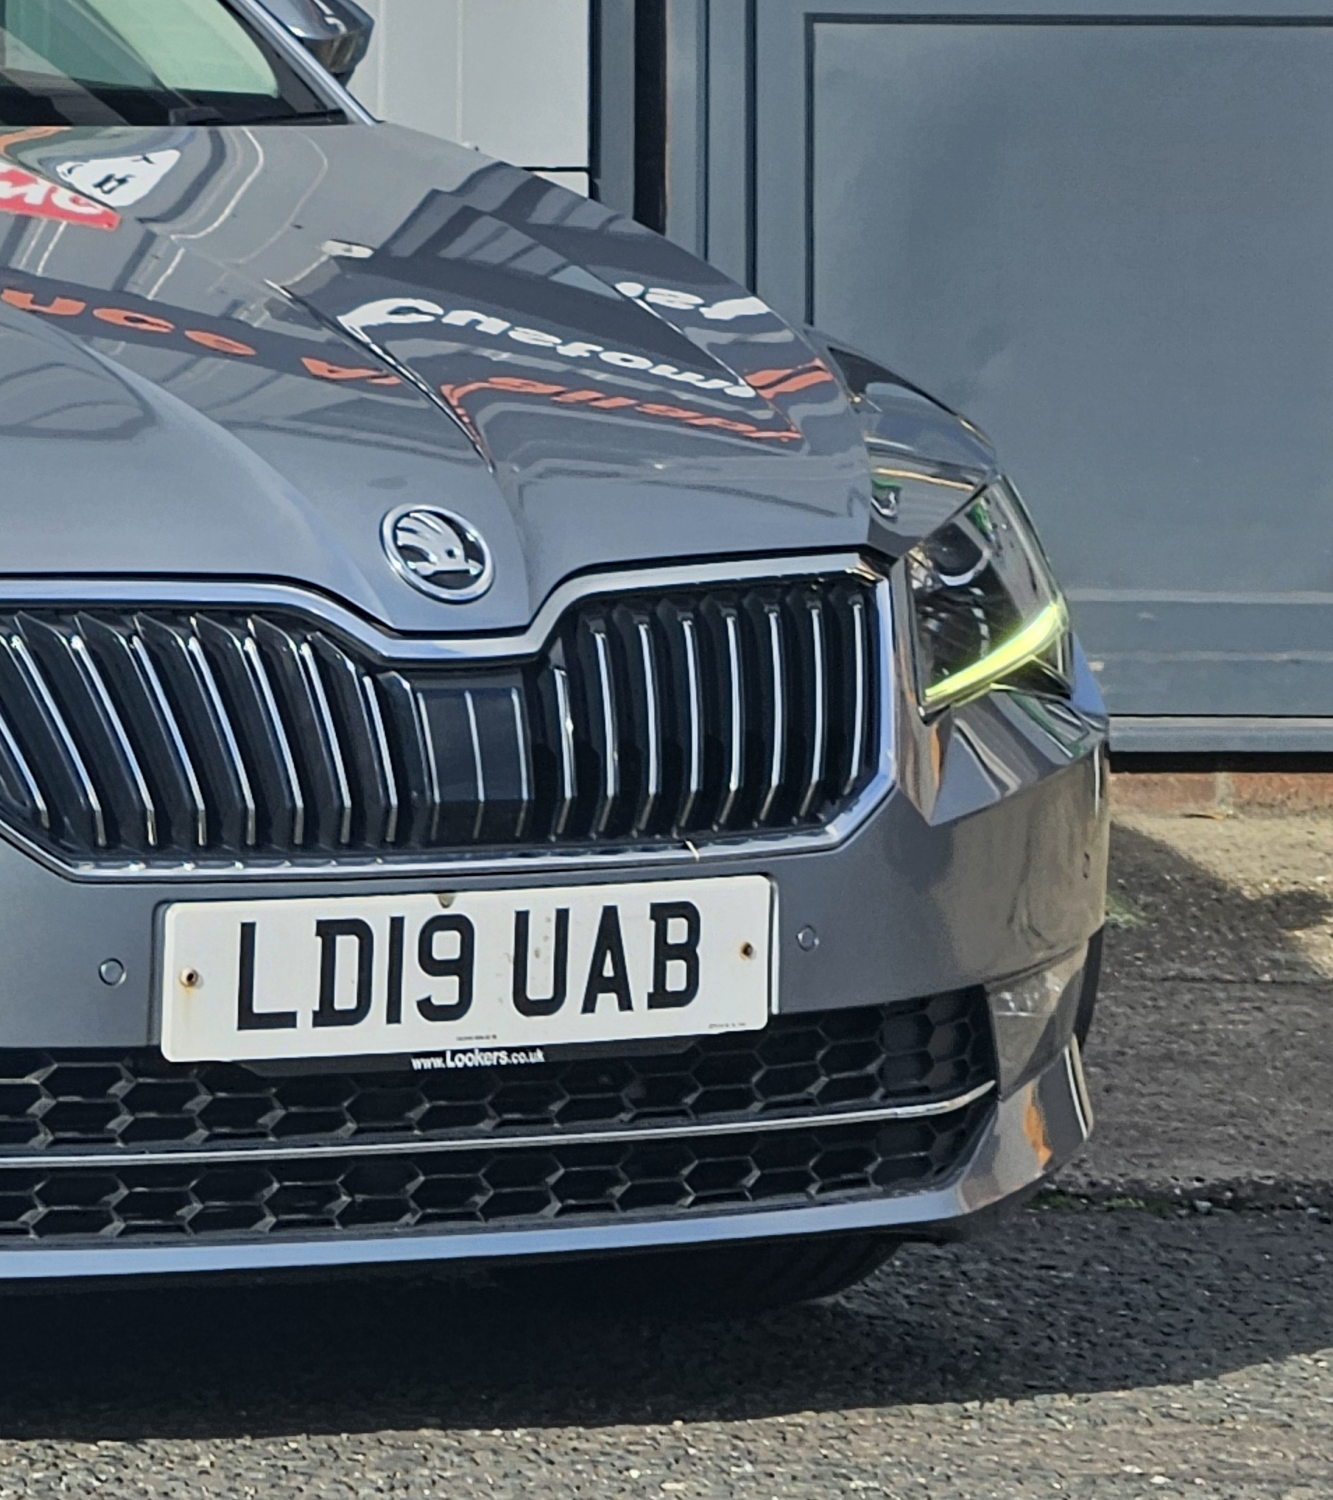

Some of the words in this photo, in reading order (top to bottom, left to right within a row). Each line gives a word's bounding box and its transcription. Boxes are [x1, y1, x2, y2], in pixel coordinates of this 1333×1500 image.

[235, 913, 475, 1031] LD19
[511, 900, 702, 1018] UAB
[411, 1048, 546, 1071] www.Lookers.co.uk
